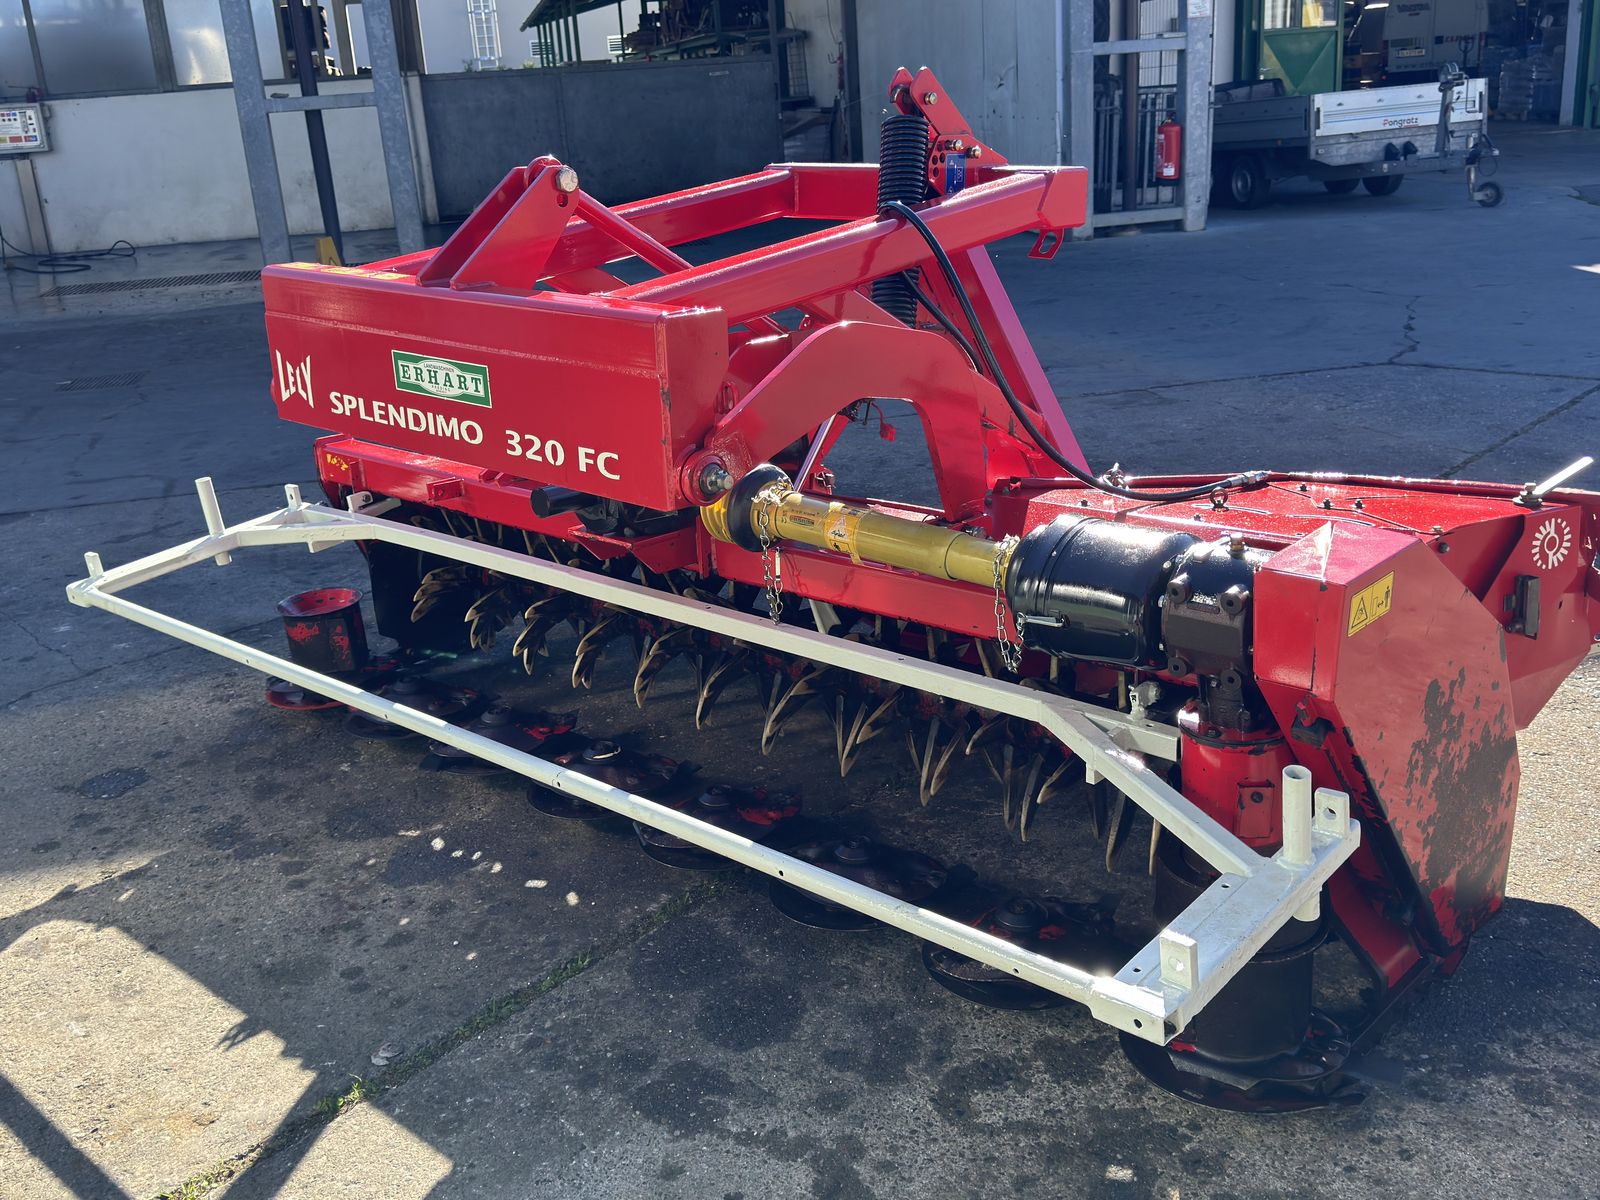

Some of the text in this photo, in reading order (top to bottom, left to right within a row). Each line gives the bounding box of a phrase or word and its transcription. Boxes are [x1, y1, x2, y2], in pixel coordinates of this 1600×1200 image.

[275, 349, 314, 409] LELY
[400, 363, 482, 393] ERHART
[329, 391, 621, 481] SPLENDIMO 320 FC
